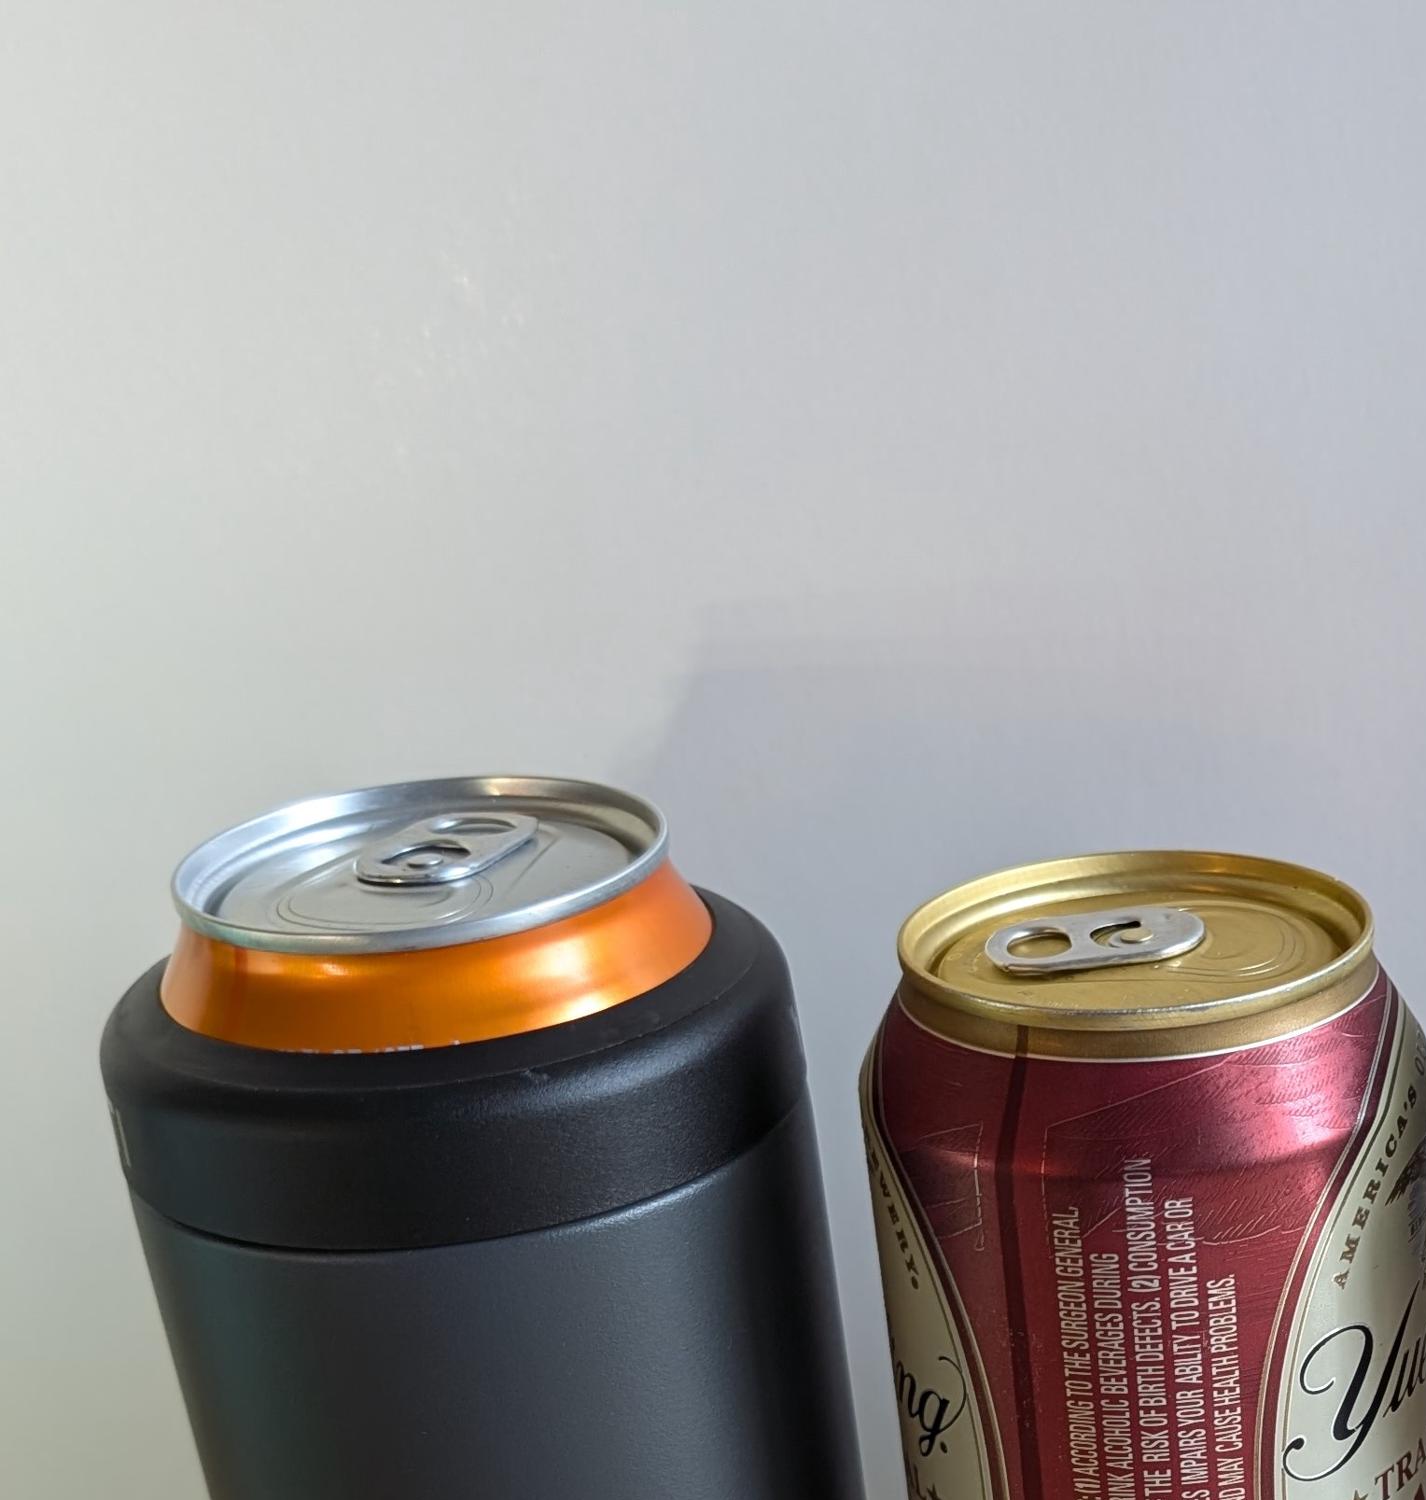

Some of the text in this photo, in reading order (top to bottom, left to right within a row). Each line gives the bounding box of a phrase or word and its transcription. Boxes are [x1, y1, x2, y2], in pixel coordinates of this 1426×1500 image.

[1123, 1158, 1158, 1271] CONSUMPTION
[1166, 1221, 1194, 1250] CAR
[1089, 1253, 1122, 1308] DURING
[1168, 1266, 1198, 1308] DRIVE
[1057, 1280, 1090, 1350] SURGEON
[1131, 1296, 1164, 1362] DEFECTS.
[1206, 1274, 1238, 1353] PROBLEMS.
[1094, 1313, 1128, 1394] BEVERAGES
[1172, 1335, 1203, 1384] ABILITY
[1211, 1355, 1240, 1405] HEALTH
[1136, 1364, 1167, 1406] BIRTH
[1175, 1388, 1205, 1429] YOUR
[1066, 1398, 1099, 1475] ACCORDING
[1101, 1399, 1134, 1470] ALCOHOLIC
[1141, 1429, 1170, 1463] RISK
[1177, 1429, 1208, 1484] IMPAIRS
[1213, 1406, 1243, 1452] CAUSE
